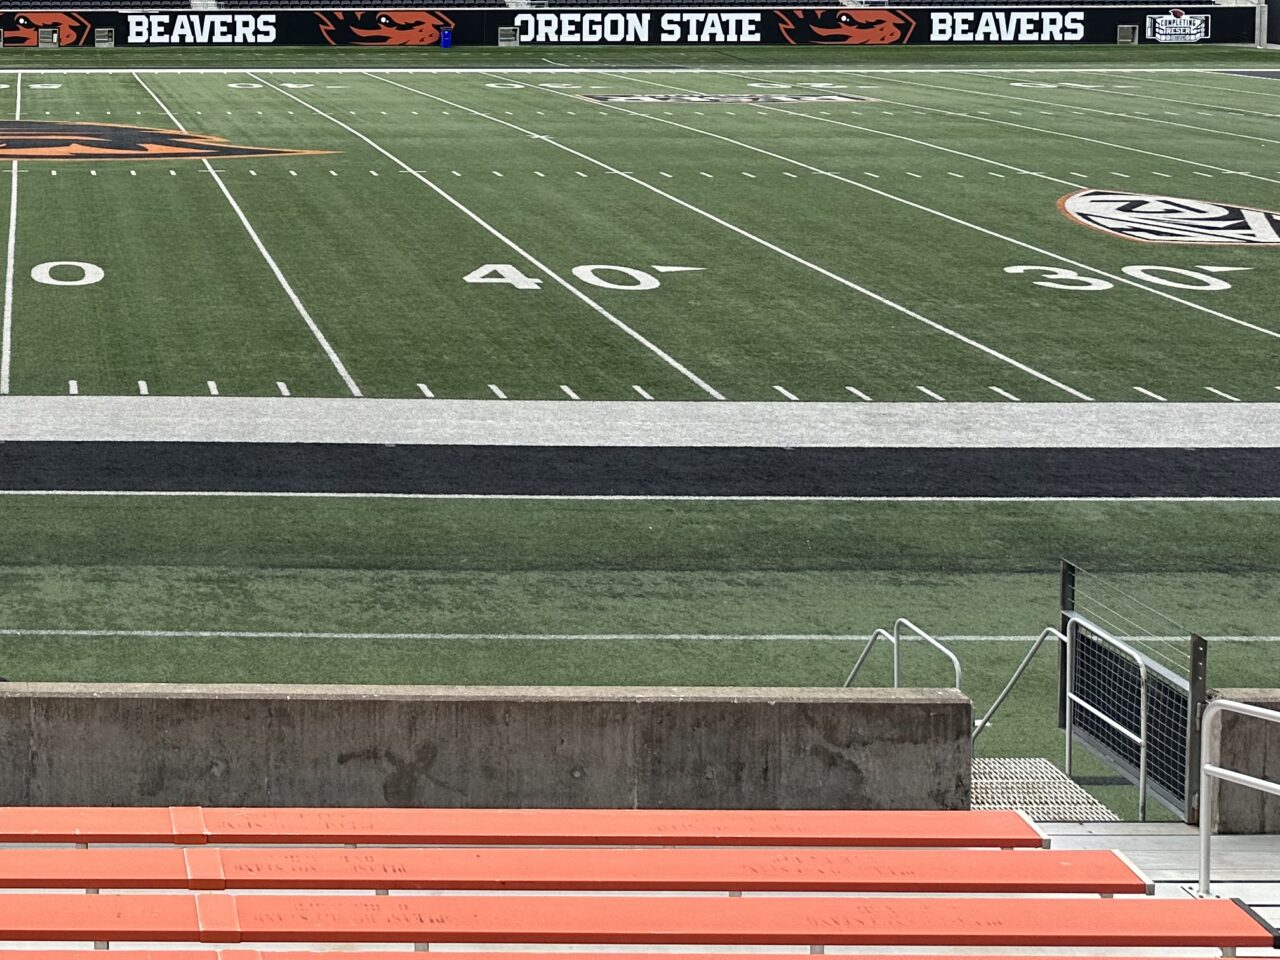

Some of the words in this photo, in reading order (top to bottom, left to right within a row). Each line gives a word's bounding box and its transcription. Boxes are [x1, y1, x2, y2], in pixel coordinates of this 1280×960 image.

[128, 15, 276, 42] BEAVERS
[514, 13, 650, 41] OREGON
[661, 13, 761, 41] STATE
[930, 12, 1084, 40] BEAVERS
